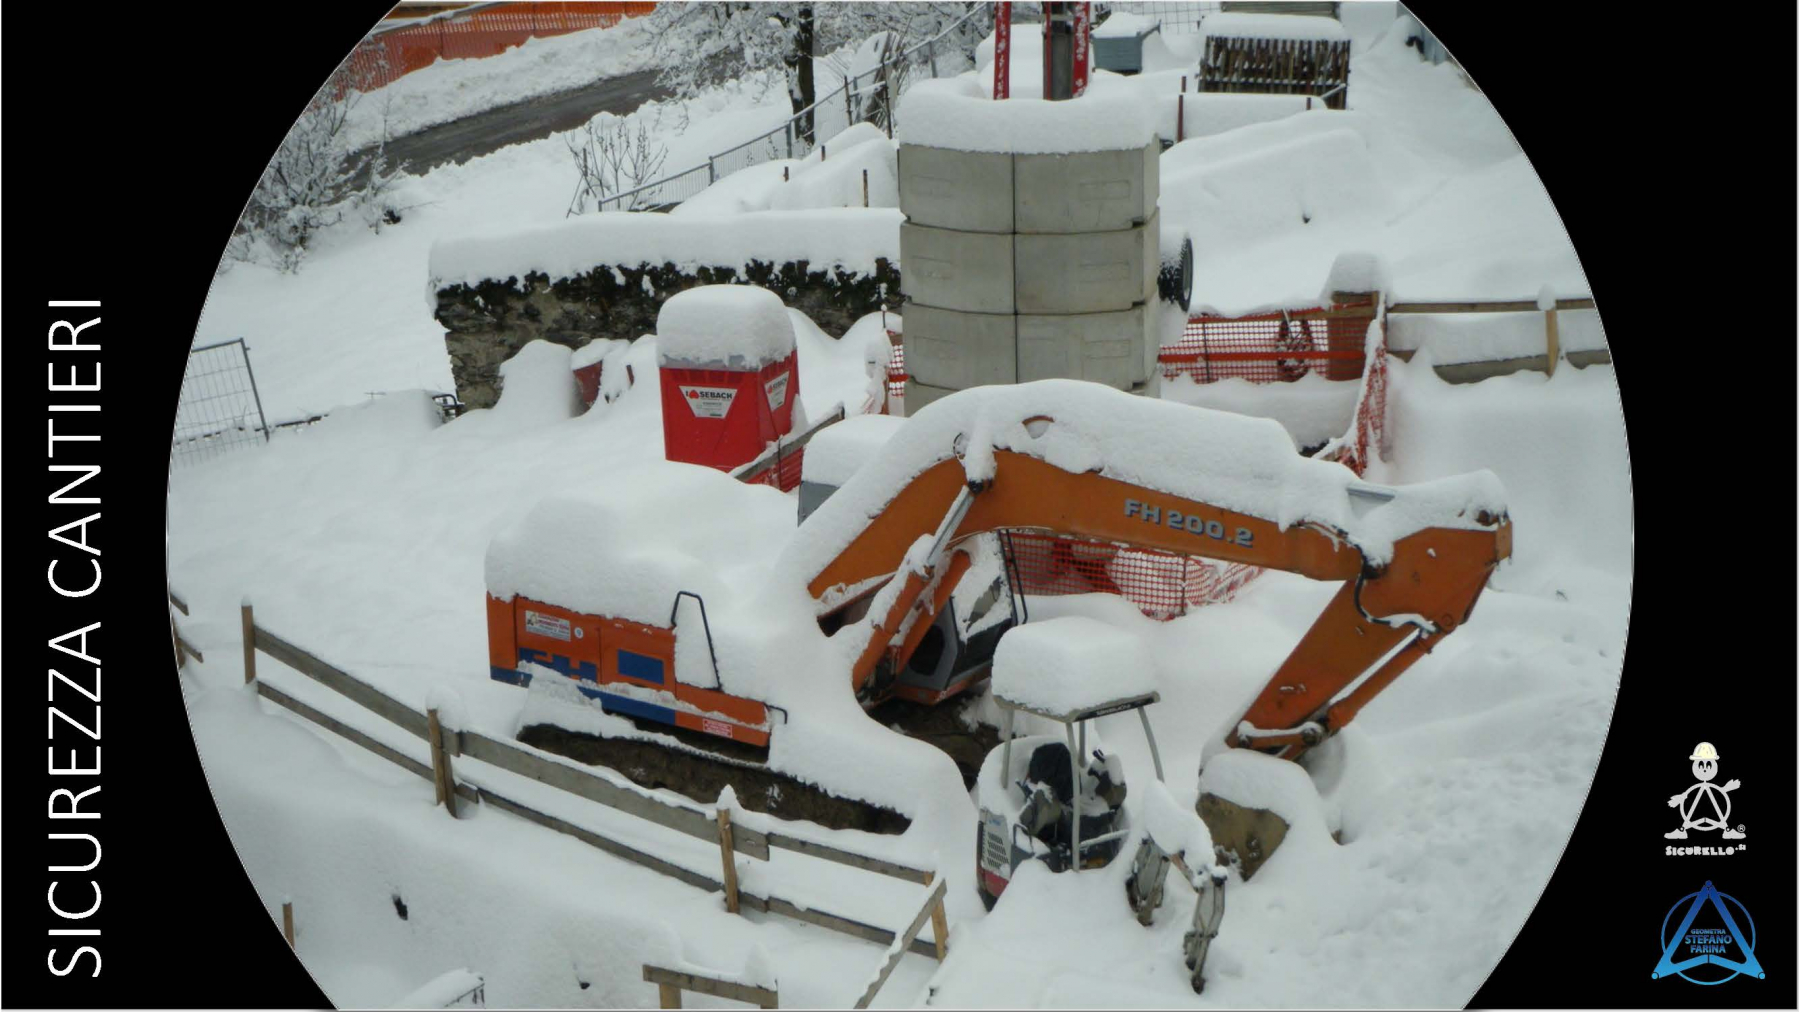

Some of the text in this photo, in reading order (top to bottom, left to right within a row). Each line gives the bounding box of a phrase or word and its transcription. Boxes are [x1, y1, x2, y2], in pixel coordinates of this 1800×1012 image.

[699, 391, 733, 399] SEBACH
[1124, 498, 1254, 548] FH 200.2
